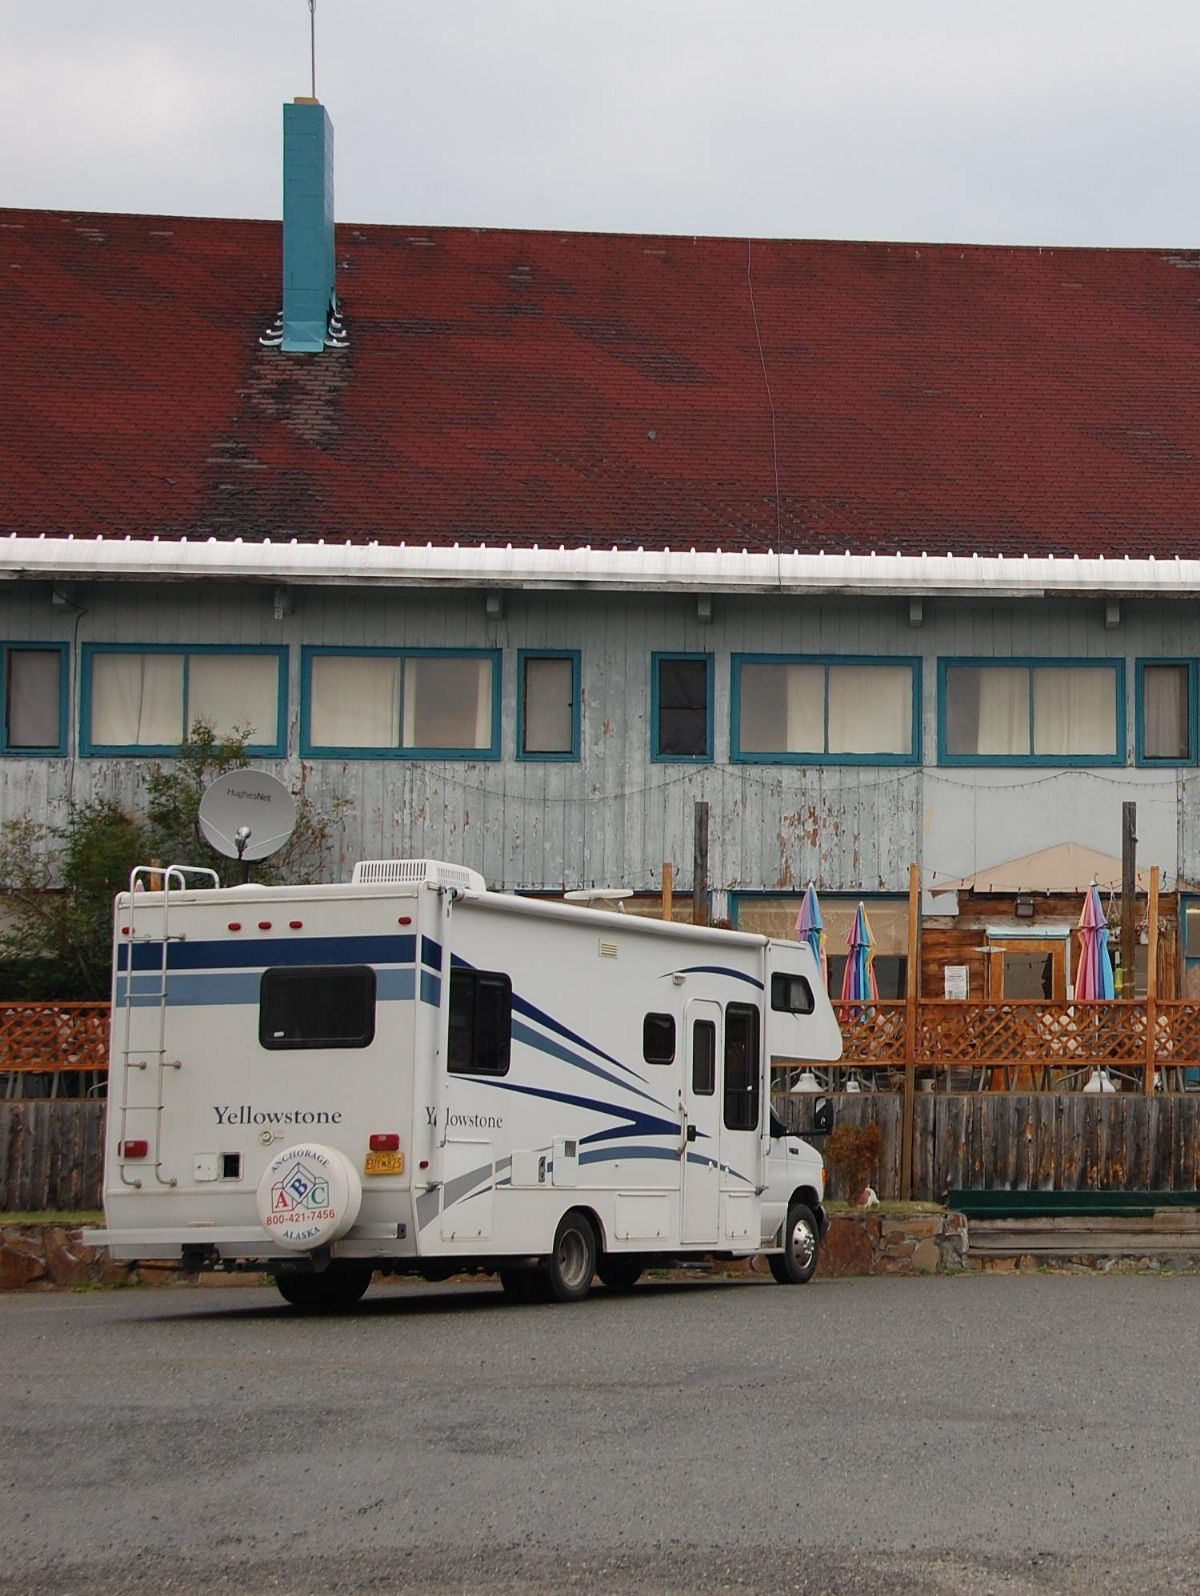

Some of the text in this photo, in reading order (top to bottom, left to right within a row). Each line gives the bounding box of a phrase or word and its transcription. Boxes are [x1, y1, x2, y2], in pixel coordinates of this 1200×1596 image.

[227, 787, 271, 802] HughesNet
[213, 1105, 344, 1125] Yellowstone
[425, 1105, 504, 1129] Ylowstone
[270, 1148, 331, 1174] ANCHORAGE
[266, 1208, 336, 1227] 800-421-7456
[282, 1226, 321, 1241] ALASKA
